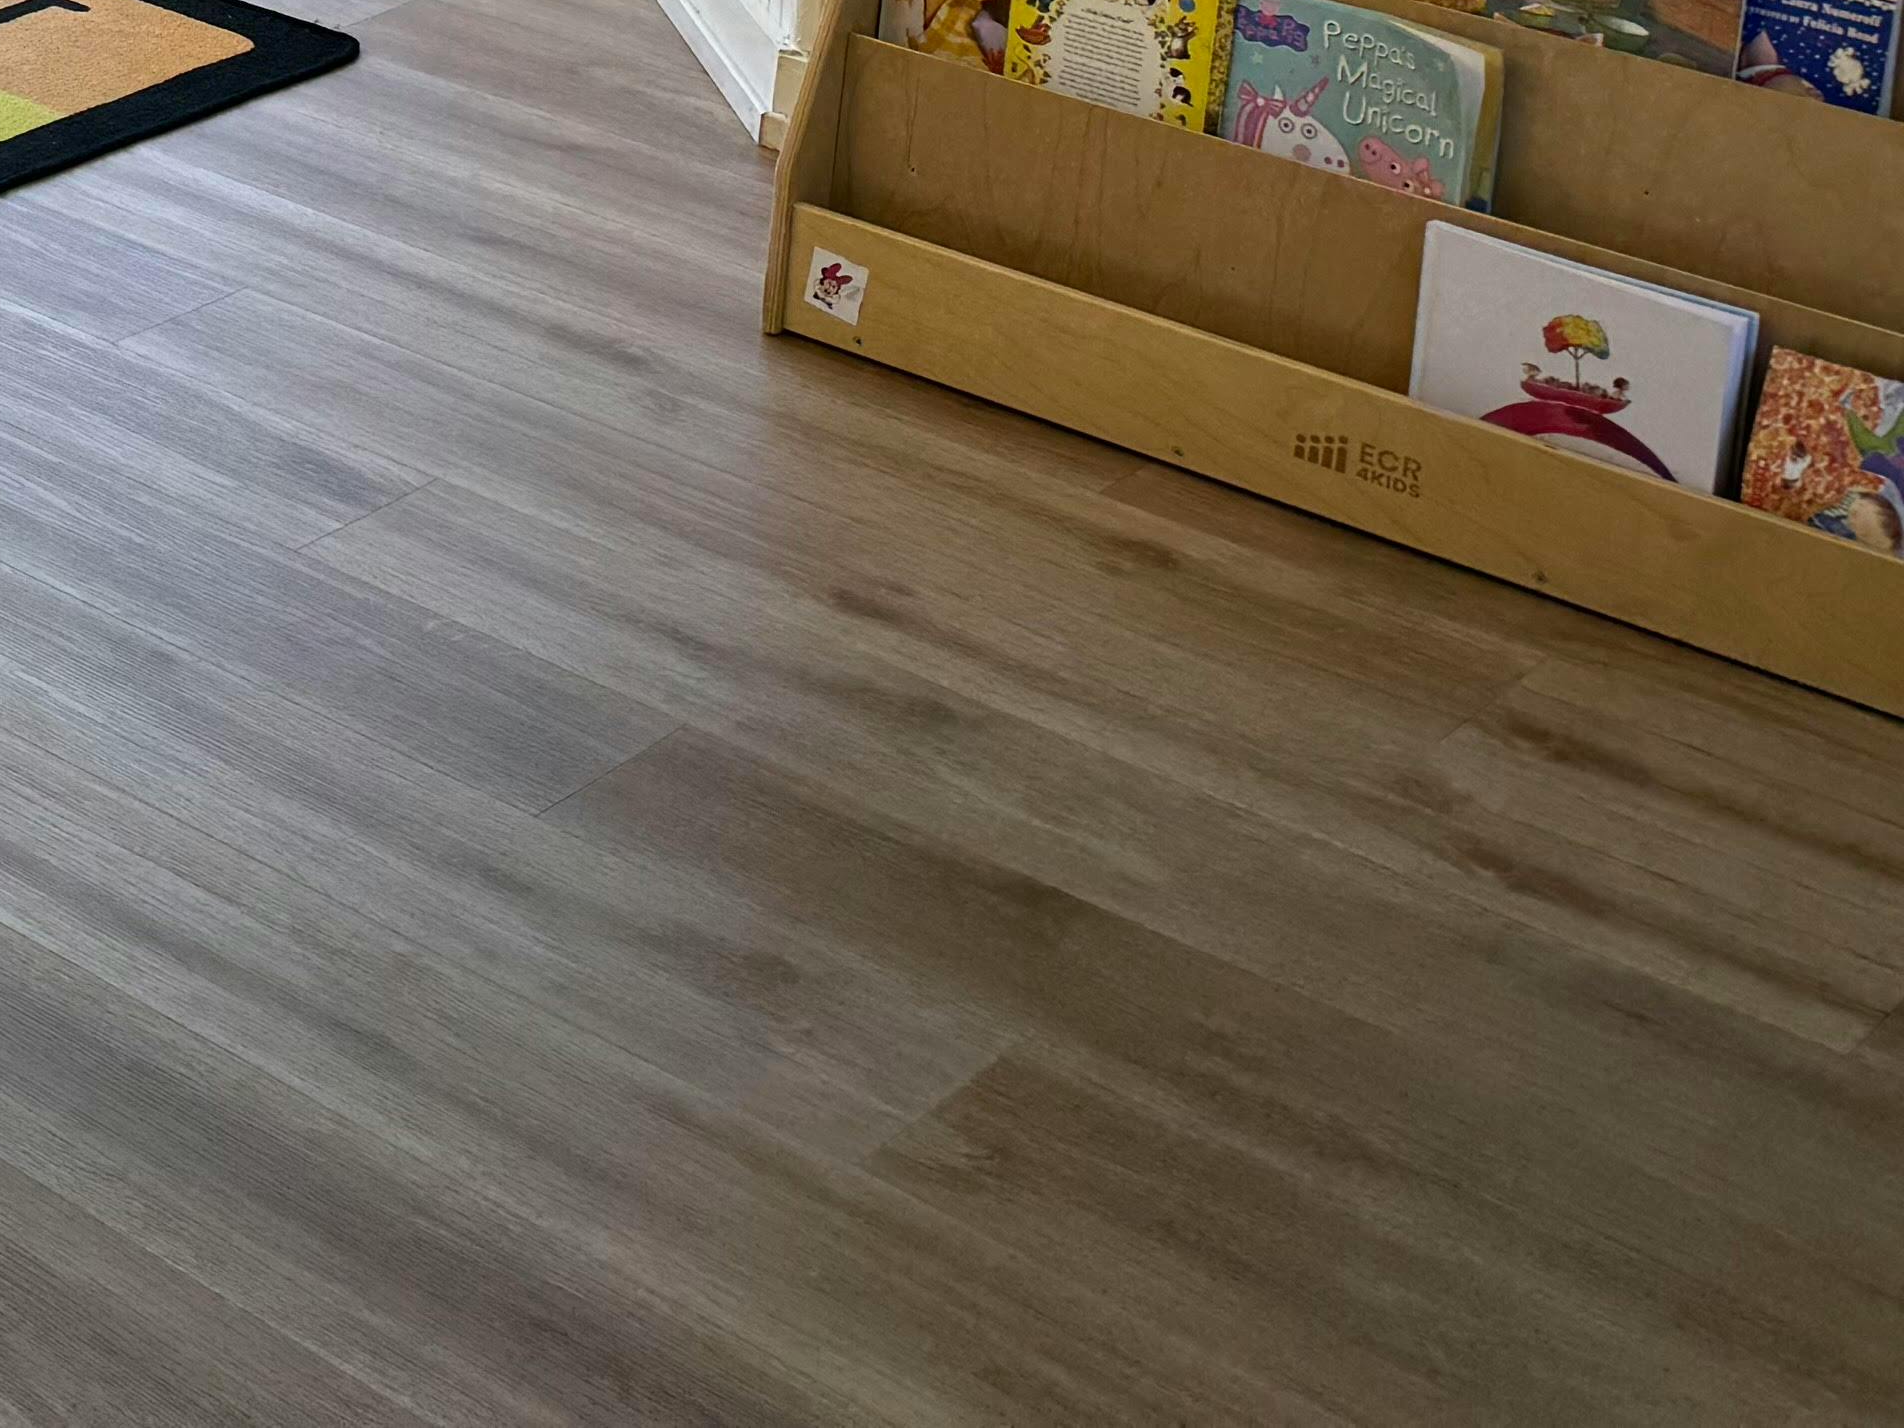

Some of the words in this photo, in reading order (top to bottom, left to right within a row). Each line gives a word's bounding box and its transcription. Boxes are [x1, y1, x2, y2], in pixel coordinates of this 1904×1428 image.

[1323, 19, 1416, 70] Peppa's
[1337, 54, 1437, 117] Magical
[1342, 90, 1454, 159] Unicorn
[1356, 467, 1420, 498] 4KIDS
[1360, 442, 1422, 482] ECR
